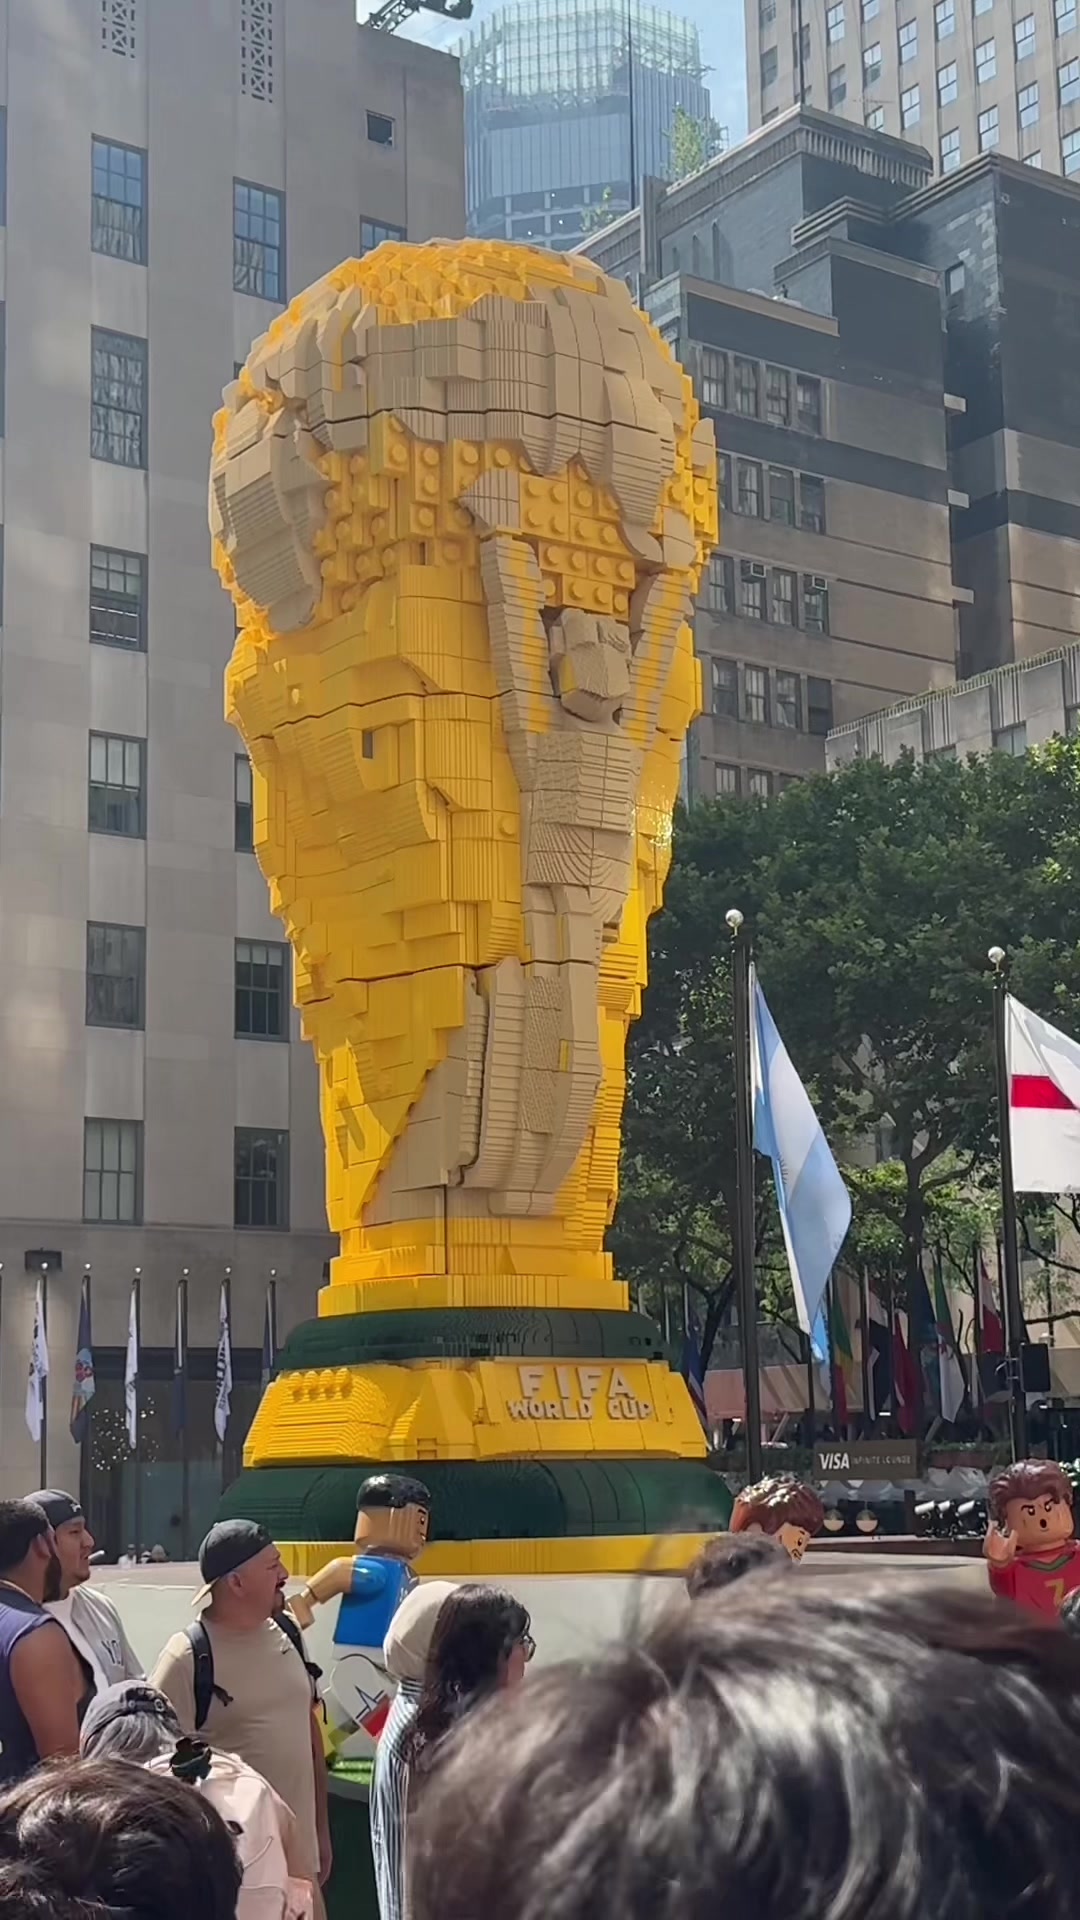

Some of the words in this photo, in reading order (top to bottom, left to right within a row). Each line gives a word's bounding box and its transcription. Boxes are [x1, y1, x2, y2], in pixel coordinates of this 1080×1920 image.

[518, 1366, 635, 1398] FIFA
[509, 1400, 594, 1420] WORLD
[608, 1400, 653, 1420] CUP
[819, 1452, 850, 1470] VISA
[1044, 1578, 1065, 1614] 7
